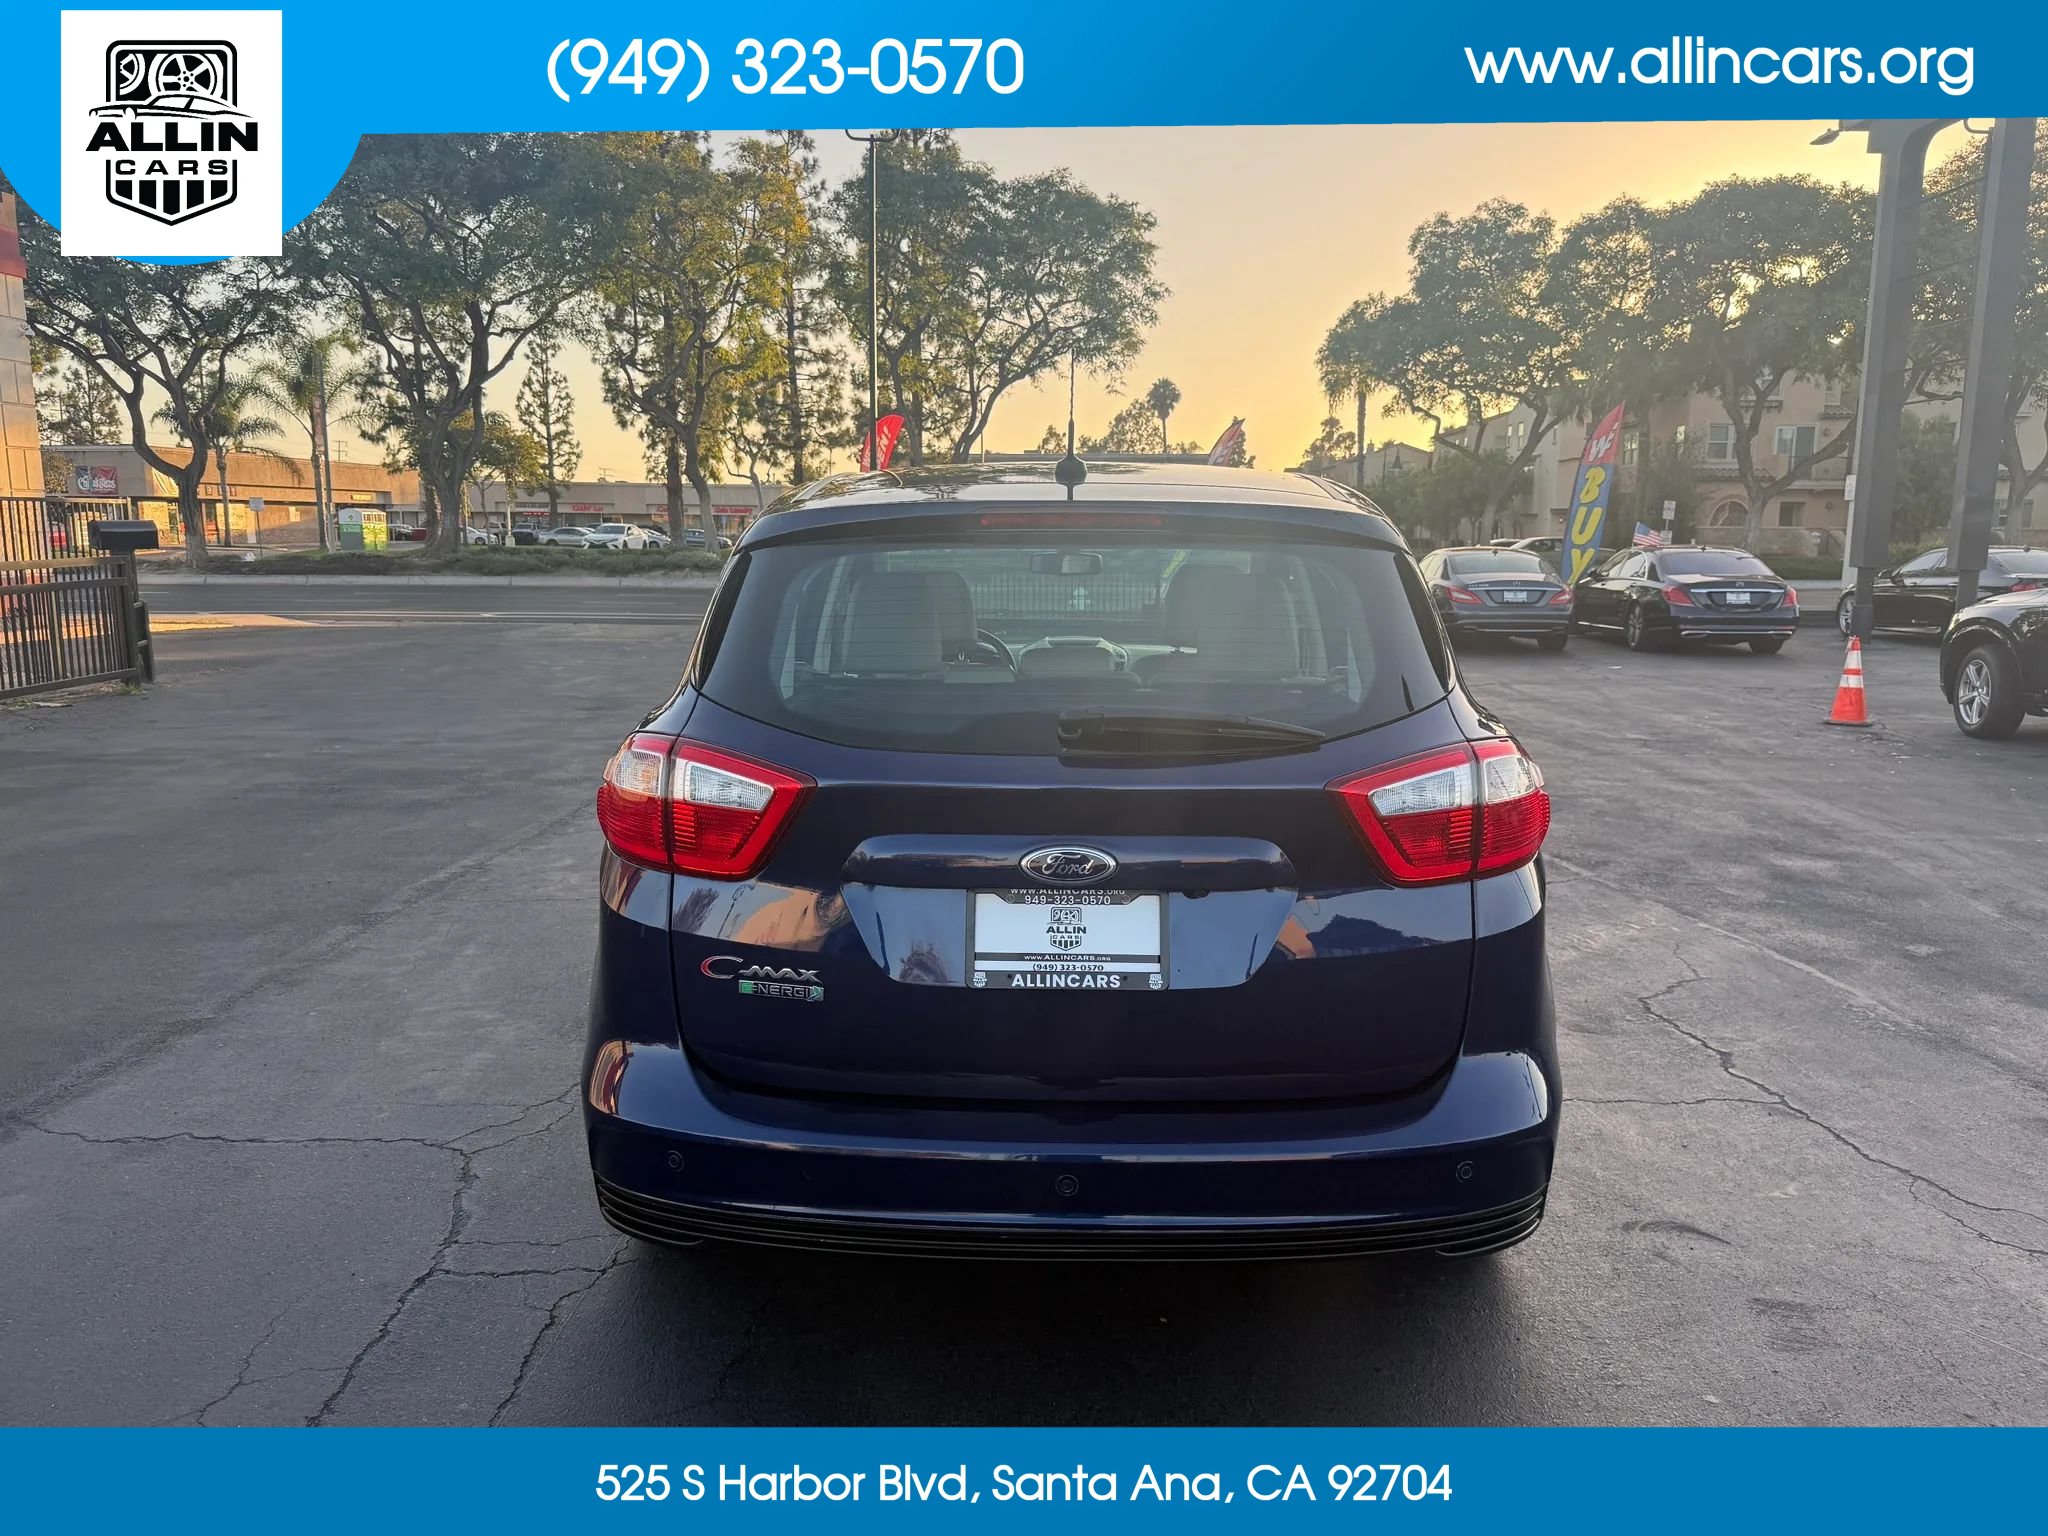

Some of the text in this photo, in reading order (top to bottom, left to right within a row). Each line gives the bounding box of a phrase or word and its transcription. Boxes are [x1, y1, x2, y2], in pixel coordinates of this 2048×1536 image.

[1567, 466, 1606, 585] BUY
[1042, 853, 1095, 875] Ford
[1024, 895, 1111, 905] 949-323-0570
[1046, 926, 1087, 934] ALLIN
[1032, 963, 1104, 971] (949) 323-0570
[1012, 974, 1121, 988] ALLINCARS
[740, 980, 812, 999] ENERGI
